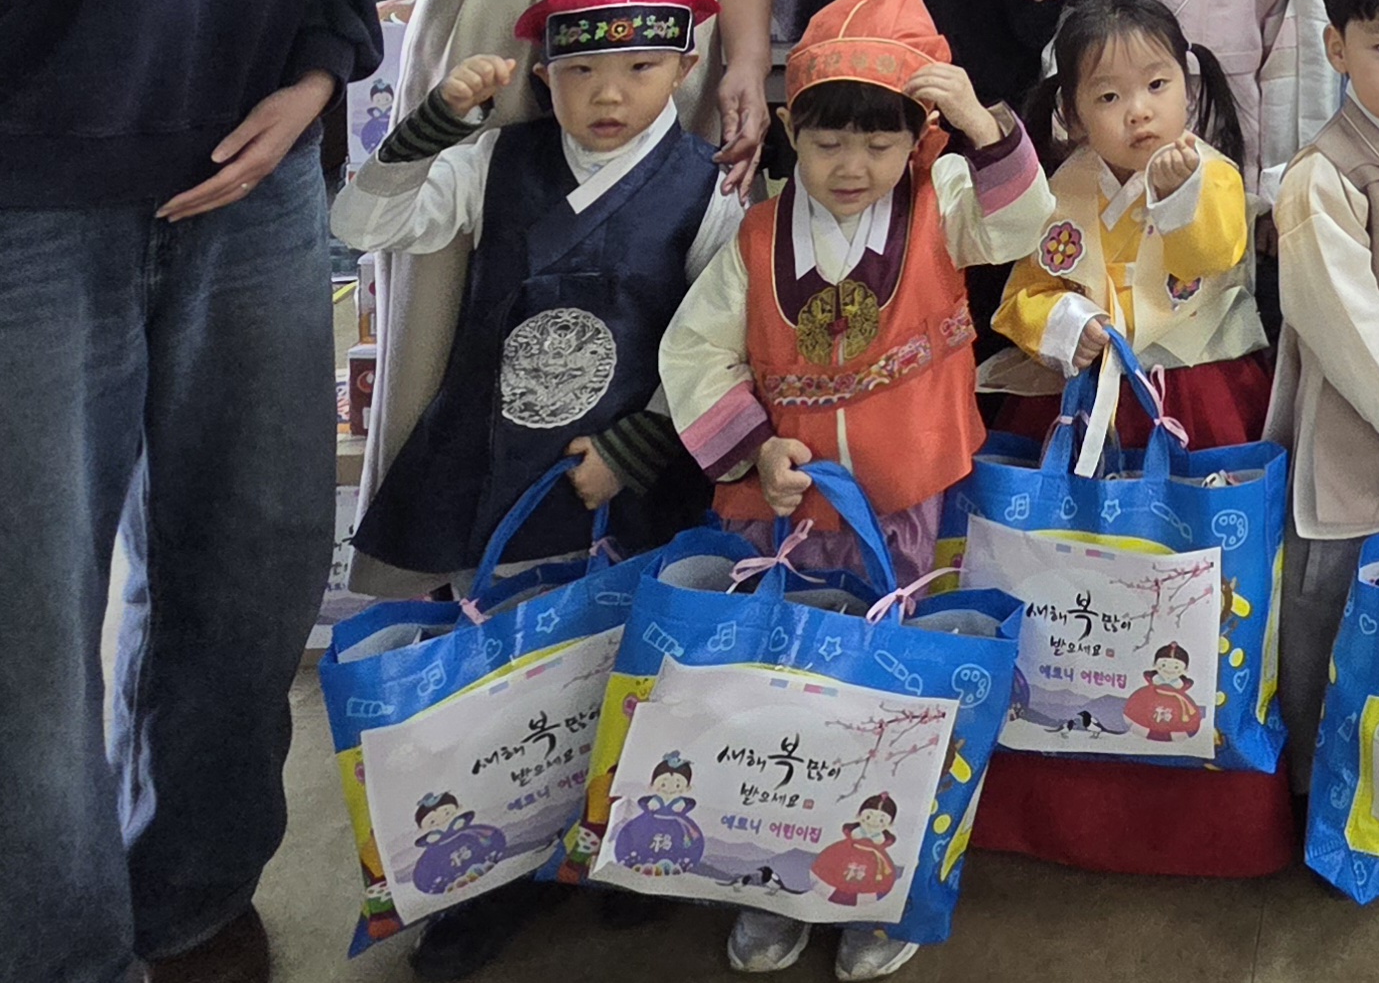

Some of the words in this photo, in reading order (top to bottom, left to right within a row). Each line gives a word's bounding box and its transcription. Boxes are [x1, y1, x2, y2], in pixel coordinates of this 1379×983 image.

[1026, 602, 1067, 626] 새해
[1066, 590, 1099, 642] 복
[1101, 612, 1131, 633] 많이
[1050, 635, 1101, 657] 받으세요
[1080, 670, 1127, 689] 어린이집
[472, 745, 526, 775] 새해
[521, 710, 561, 760] 복
[511, 748, 574, 787] 받으세요
[717, 744, 767, 773] 새해
[767, 732, 804, 791] 복
[806, 758, 841, 781] 많이
[740, 782, 800, 808] 받으세요
[769, 821, 822, 844] 어린이집
